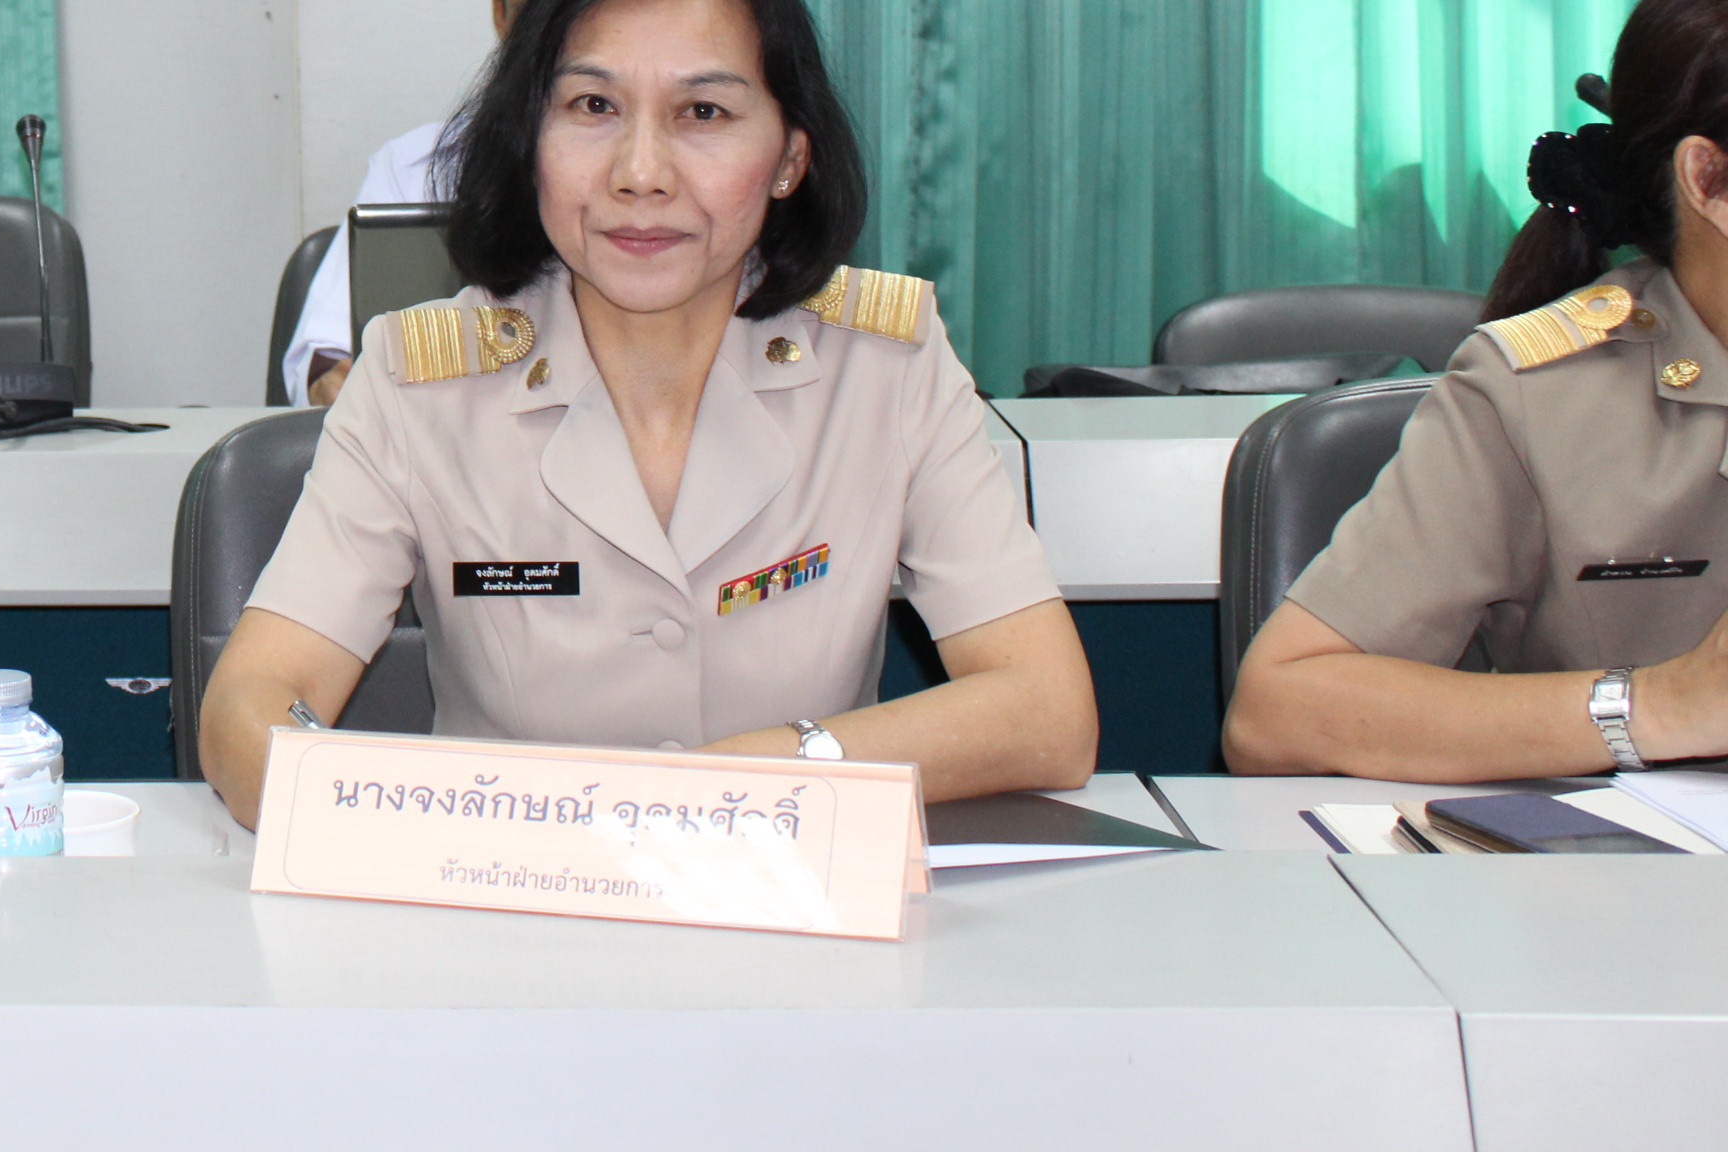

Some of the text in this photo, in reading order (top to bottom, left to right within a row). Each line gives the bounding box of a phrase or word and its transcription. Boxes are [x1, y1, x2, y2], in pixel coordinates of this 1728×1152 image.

[4, 802, 58, 831] Virgin
[332, 772, 601, 826] นางจงลักษณ์
